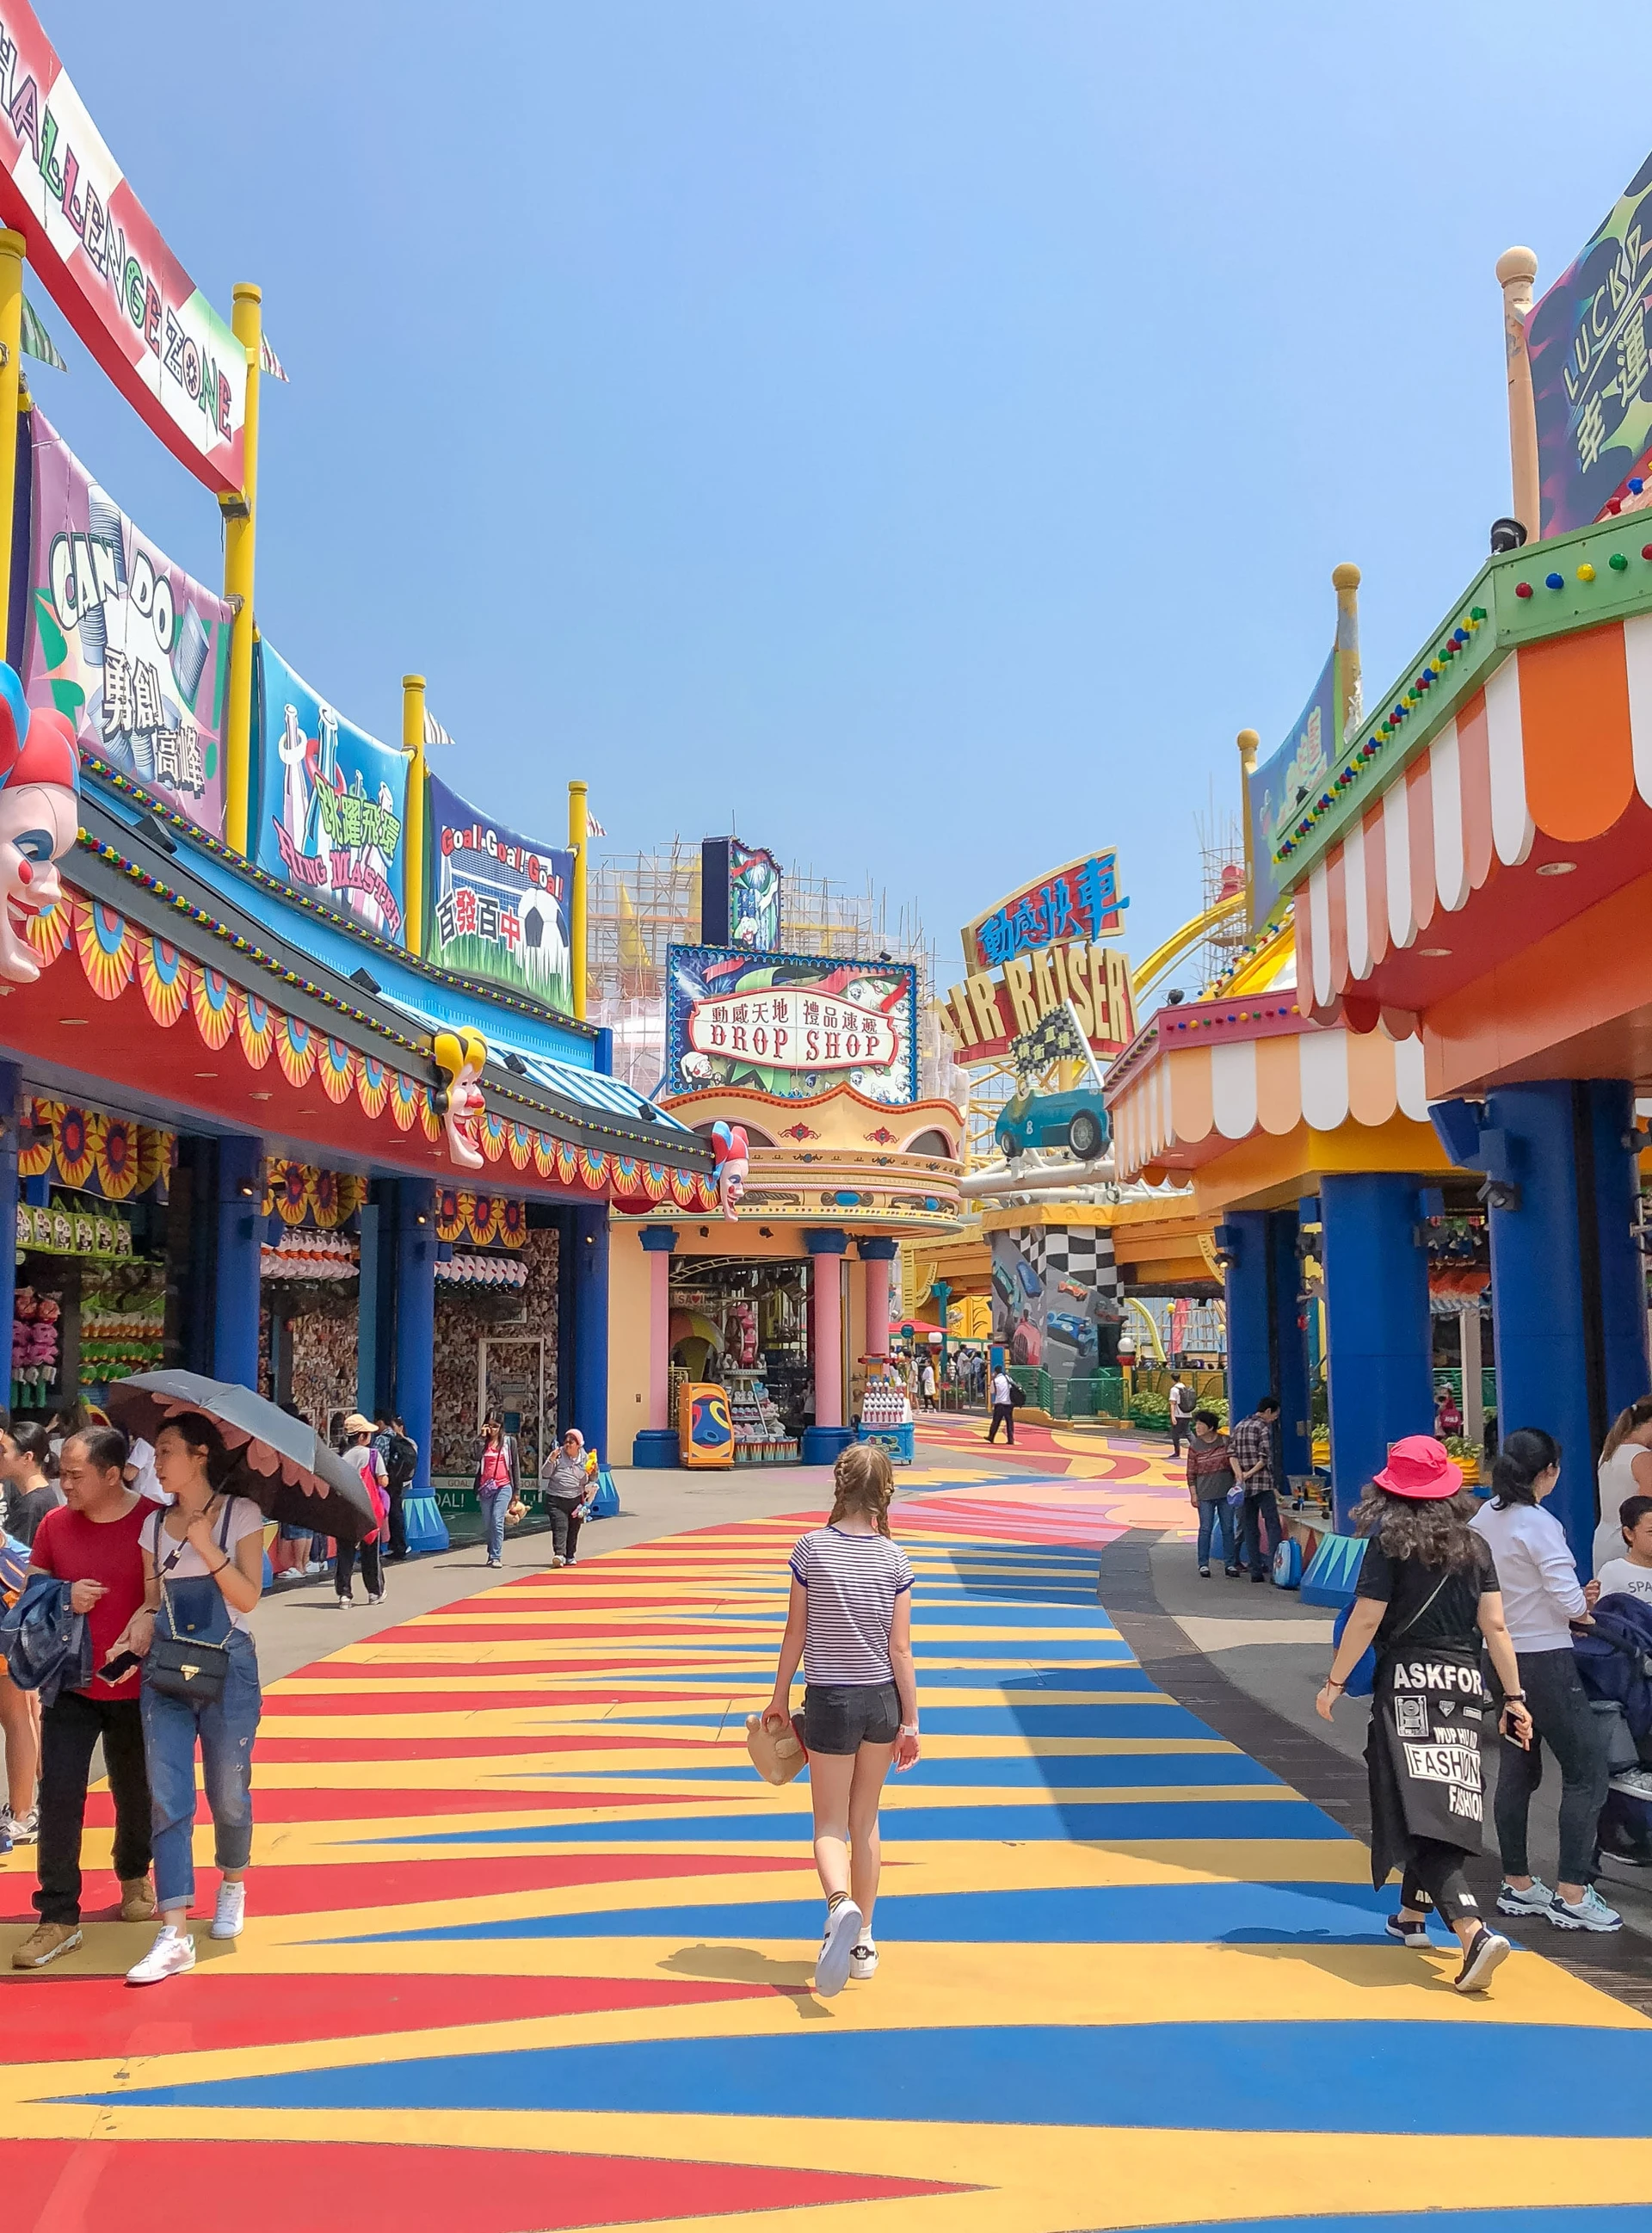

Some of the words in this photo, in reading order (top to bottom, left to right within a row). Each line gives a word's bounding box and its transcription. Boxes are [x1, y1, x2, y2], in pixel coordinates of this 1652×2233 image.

[163, 305, 232, 442] ZONE
[49, 532, 120, 631] CAN
[129, 548, 176, 654] DO
[330, 849, 402, 940] MASTER
[441, 823, 483, 857] Goal!
[485, 829, 527, 874] Goal!
[527, 854, 564, 902] Goal!
[435, 885, 522, 953] 百發百中
[978, 853, 1131, 966] 動感快車
[802, 998, 878, 1034] 禮品速遞
[1002, 946, 1137, 1046] RAISER
[710, 1024, 789, 1059] DROP
[805, 1028, 880, 1061] SHOP
[1026, 1120, 1033, 1135] 8
[447, 1479, 470, 1488] GOAL
